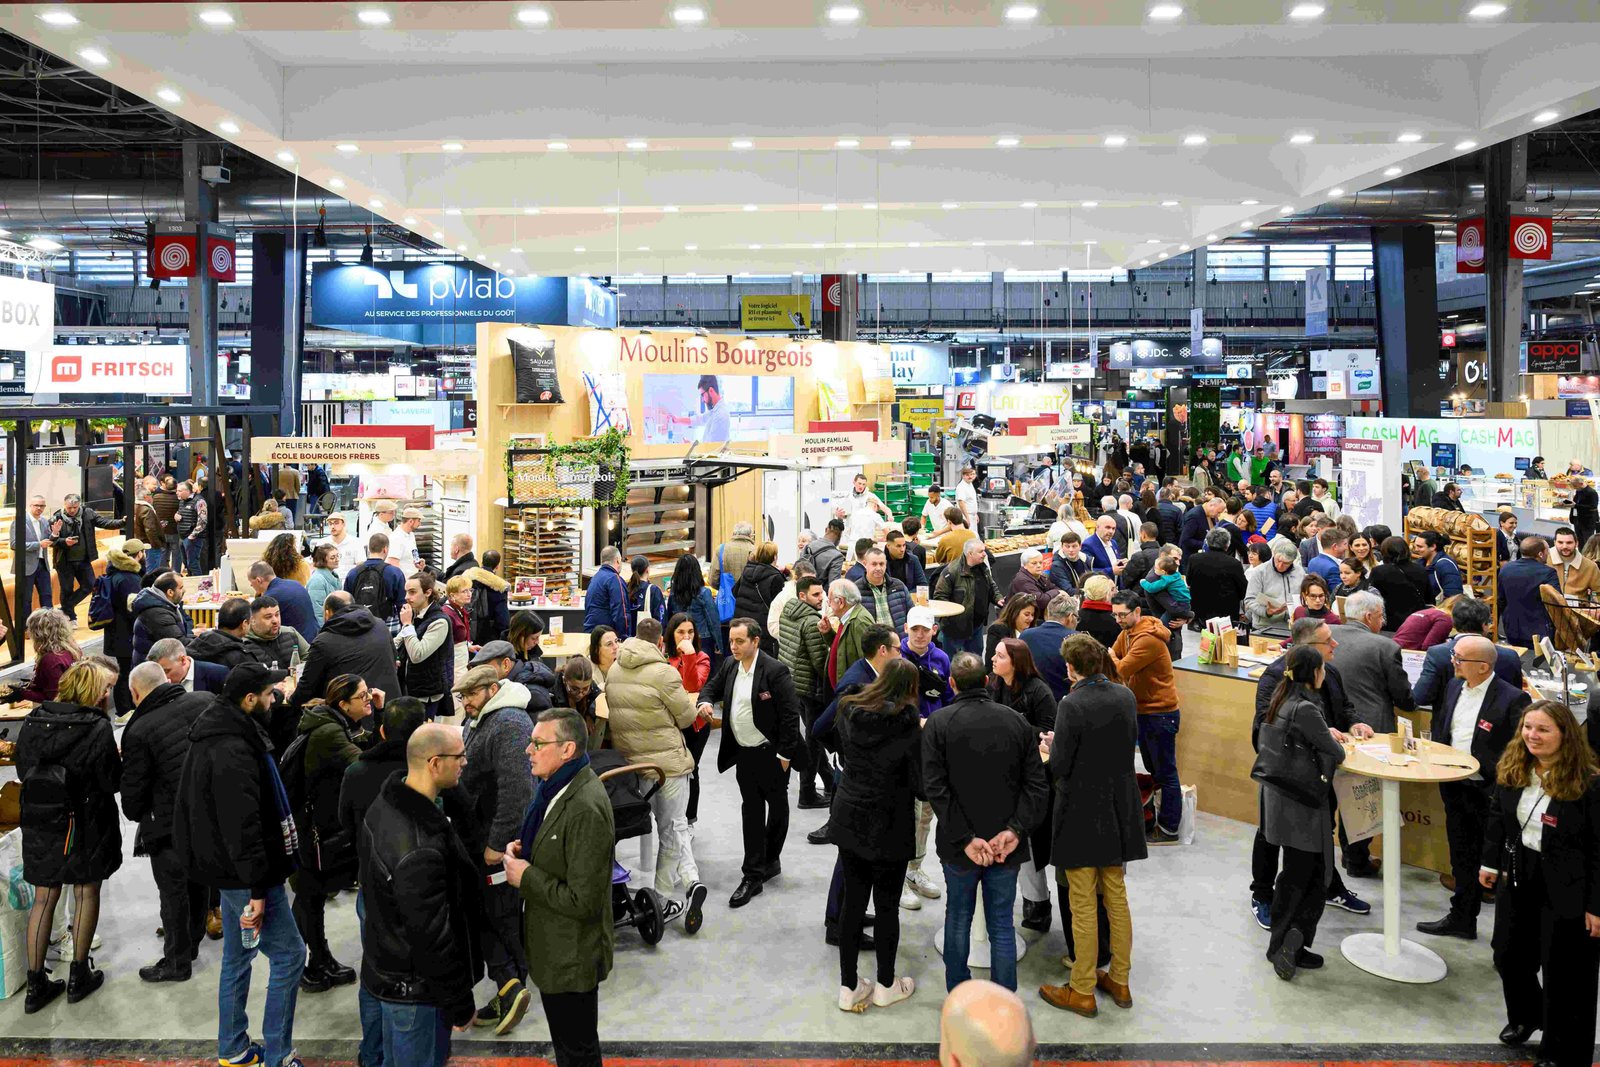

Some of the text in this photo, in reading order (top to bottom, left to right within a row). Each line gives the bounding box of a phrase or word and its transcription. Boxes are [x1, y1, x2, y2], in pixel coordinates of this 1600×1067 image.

[429, 270, 516, 306] pvlab
[1310, 273, 1322, 301] K
[2, 300, 40, 327] BOX
[421, 309, 482, 317] PROFESSIONNELS
[484, 309, 494, 317] DU
[495, 308, 515, 316] GOÛT
[619, 336, 813, 373] Moulins Bourgeois
[1149, 348, 1169, 357] JDC
[1530, 344, 1580, 361] appa
[91, 361, 173, 377] FRITSCH
[1199, 378, 1228, 386] SEMPA
[1361, 425, 1439, 450] CASHMAG
[1460, 427, 1535, 449] CASHMAG
[271, 452, 298, 460] ÉCOLE
[349, 452, 380, 460] FRÈRES
